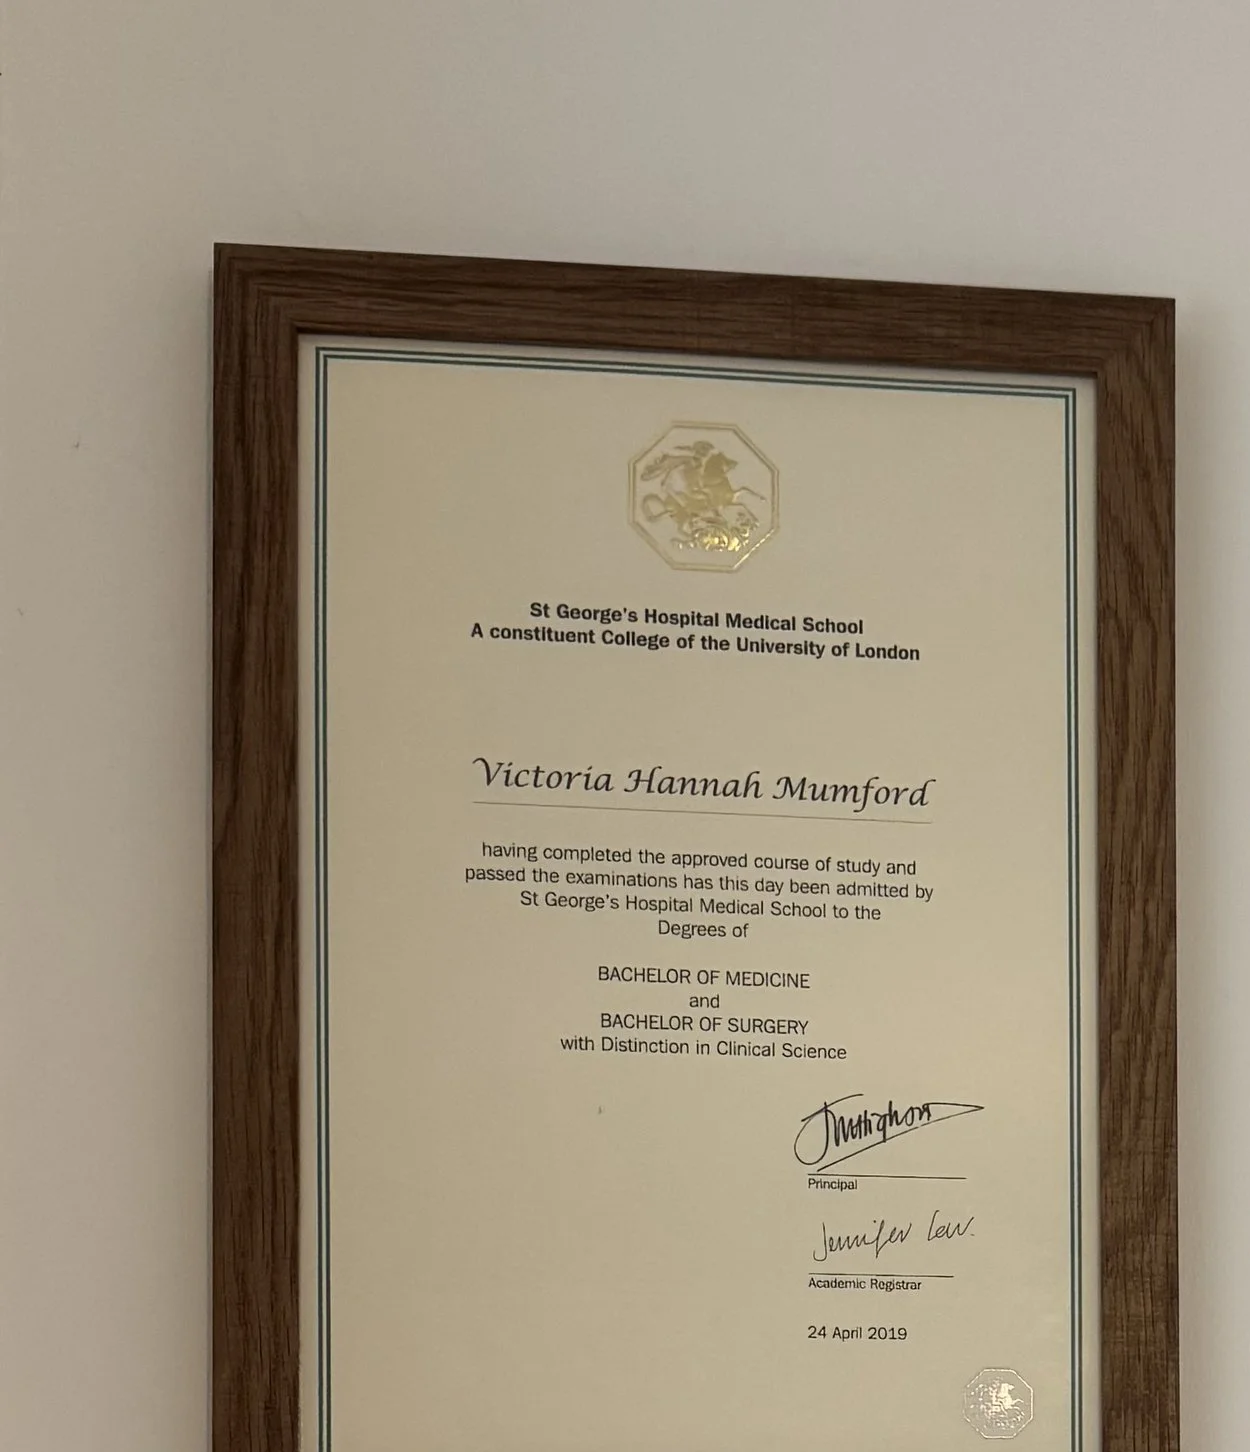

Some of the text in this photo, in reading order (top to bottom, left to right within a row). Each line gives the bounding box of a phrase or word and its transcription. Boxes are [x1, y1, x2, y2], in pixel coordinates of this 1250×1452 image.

[529, 601, 864, 635] St George's Hospital Medical School
[470, 622, 920, 661] A constituent College of the University of London
[472, 757, 937, 813] Victoria Hannah Mumford
[482, 841, 917, 878] having completed the approved course of study and
[466, 867, 934, 903] passed the examinations has this day been admitted by
[520, 890, 882, 921] St George's Hospital Medical School to the
[658, 919, 750, 940] Degrees of
[598, 965, 811, 989] BACHELOR OF MEDICINE
[689, 993, 720, 1009] and
[600, 1012, 809, 1036] BACHELOR OF SURGERY
[560, 1035, 847, 1060] with Distinction in Clinical Science
[808, 1178, 858, 1192] Principal
[808, 1277, 922, 1293] Academic Registrar
[807, 1325, 908, 1343] 24 April 2019
